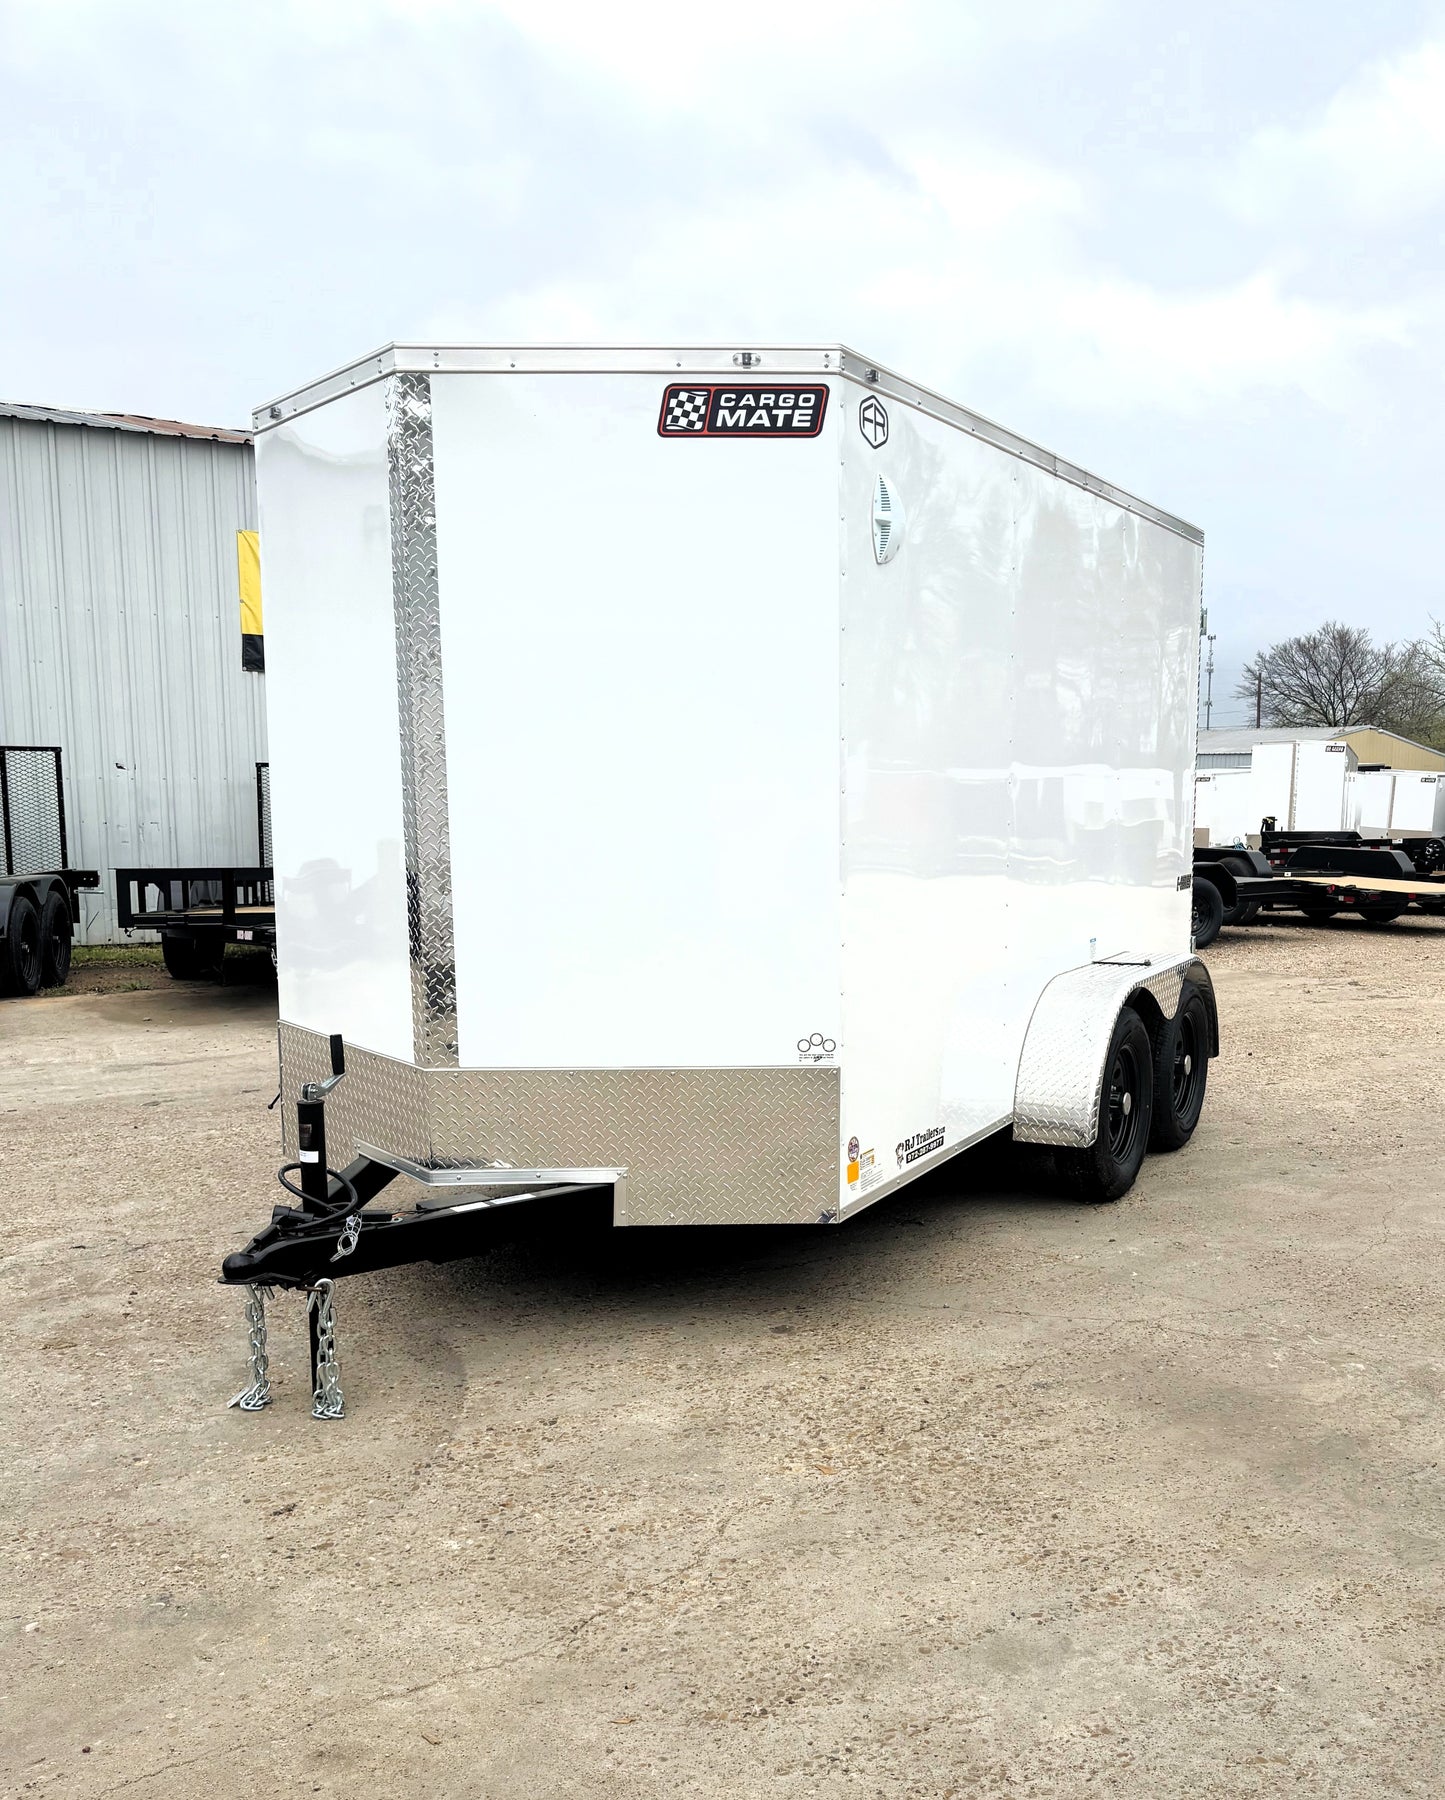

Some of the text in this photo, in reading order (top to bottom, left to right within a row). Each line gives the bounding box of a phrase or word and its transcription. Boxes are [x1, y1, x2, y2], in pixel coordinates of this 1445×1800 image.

[719, 393, 816, 407] CARGO
[715, 409, 814, 427] MATE
[904, 1136, 915, 1152] RJ
